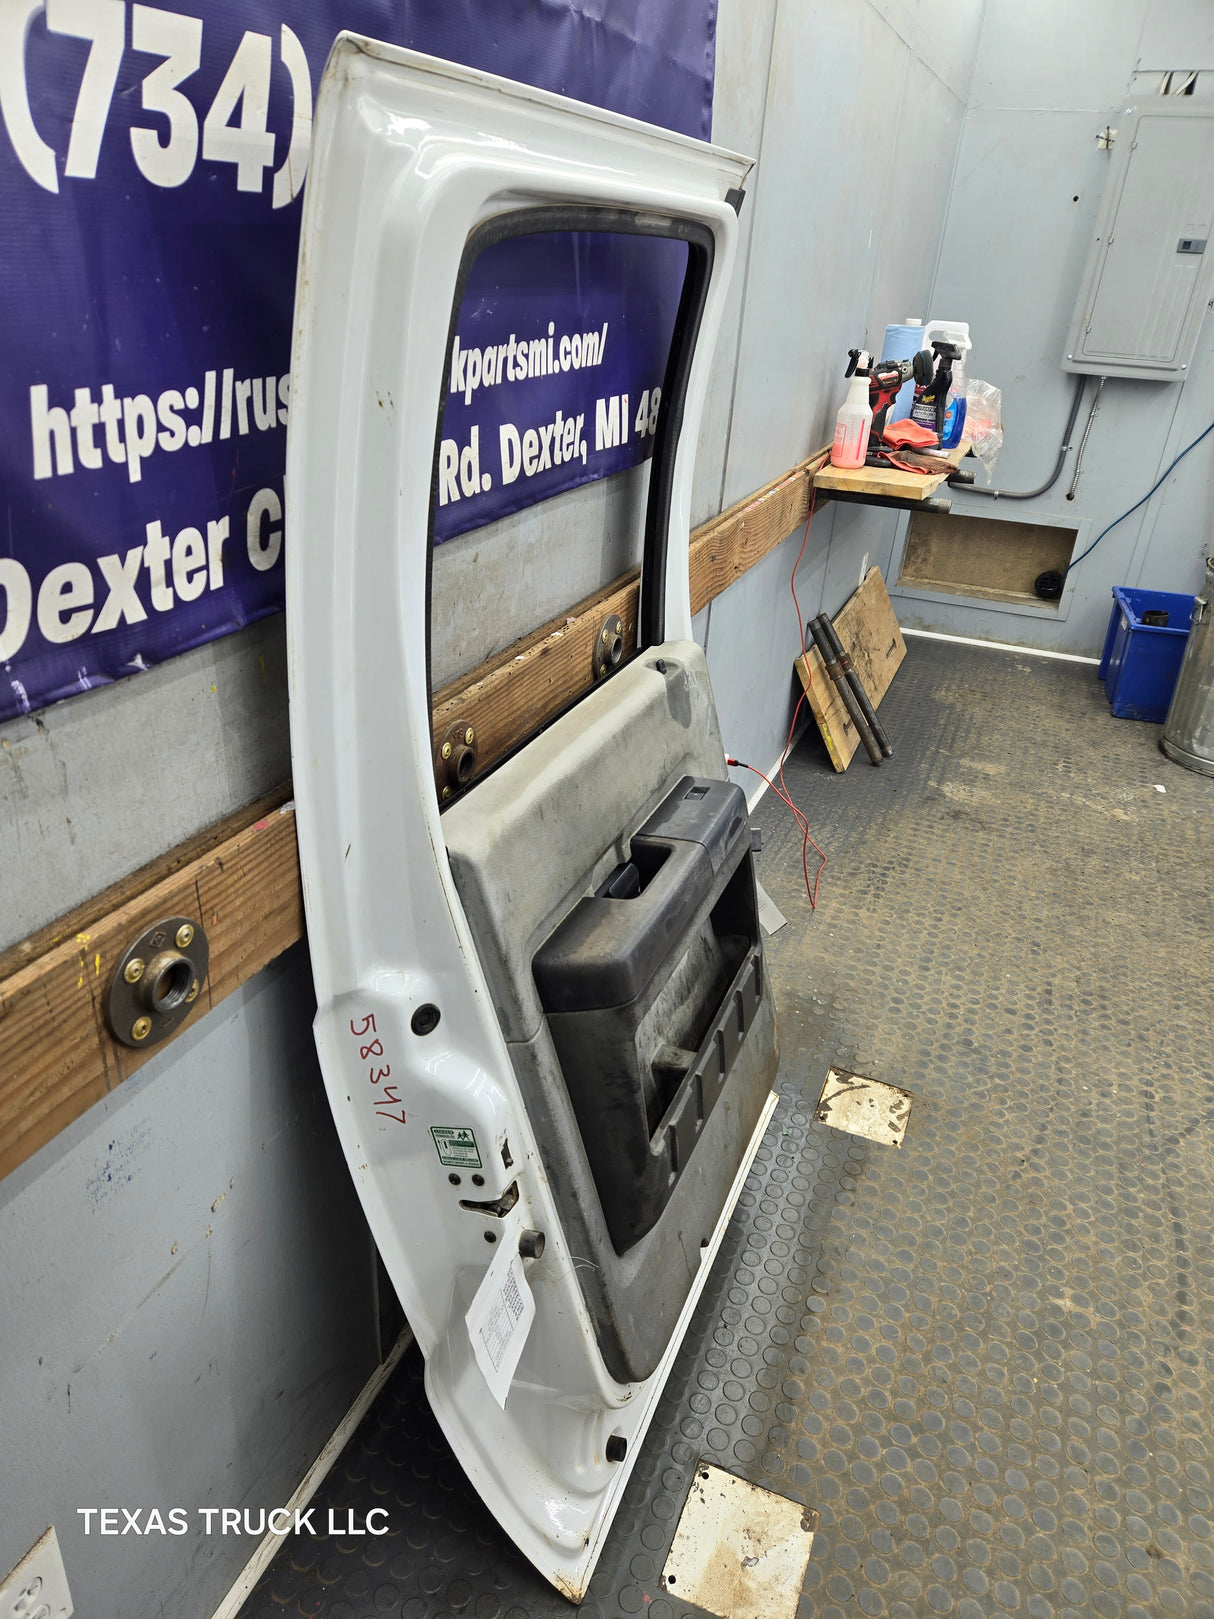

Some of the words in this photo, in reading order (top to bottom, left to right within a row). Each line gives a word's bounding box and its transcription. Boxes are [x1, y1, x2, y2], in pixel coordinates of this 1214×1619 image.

[0, 0, 312, 210] (734)
[450, 321, 608, 406] kpartsmi.com/
[439, 425, 492, 506] Rd.
[499, 410, 587, 486] Dexter,
[596, 393, 629, 451] MI
[350, 1013, 406, 1124] 58347
